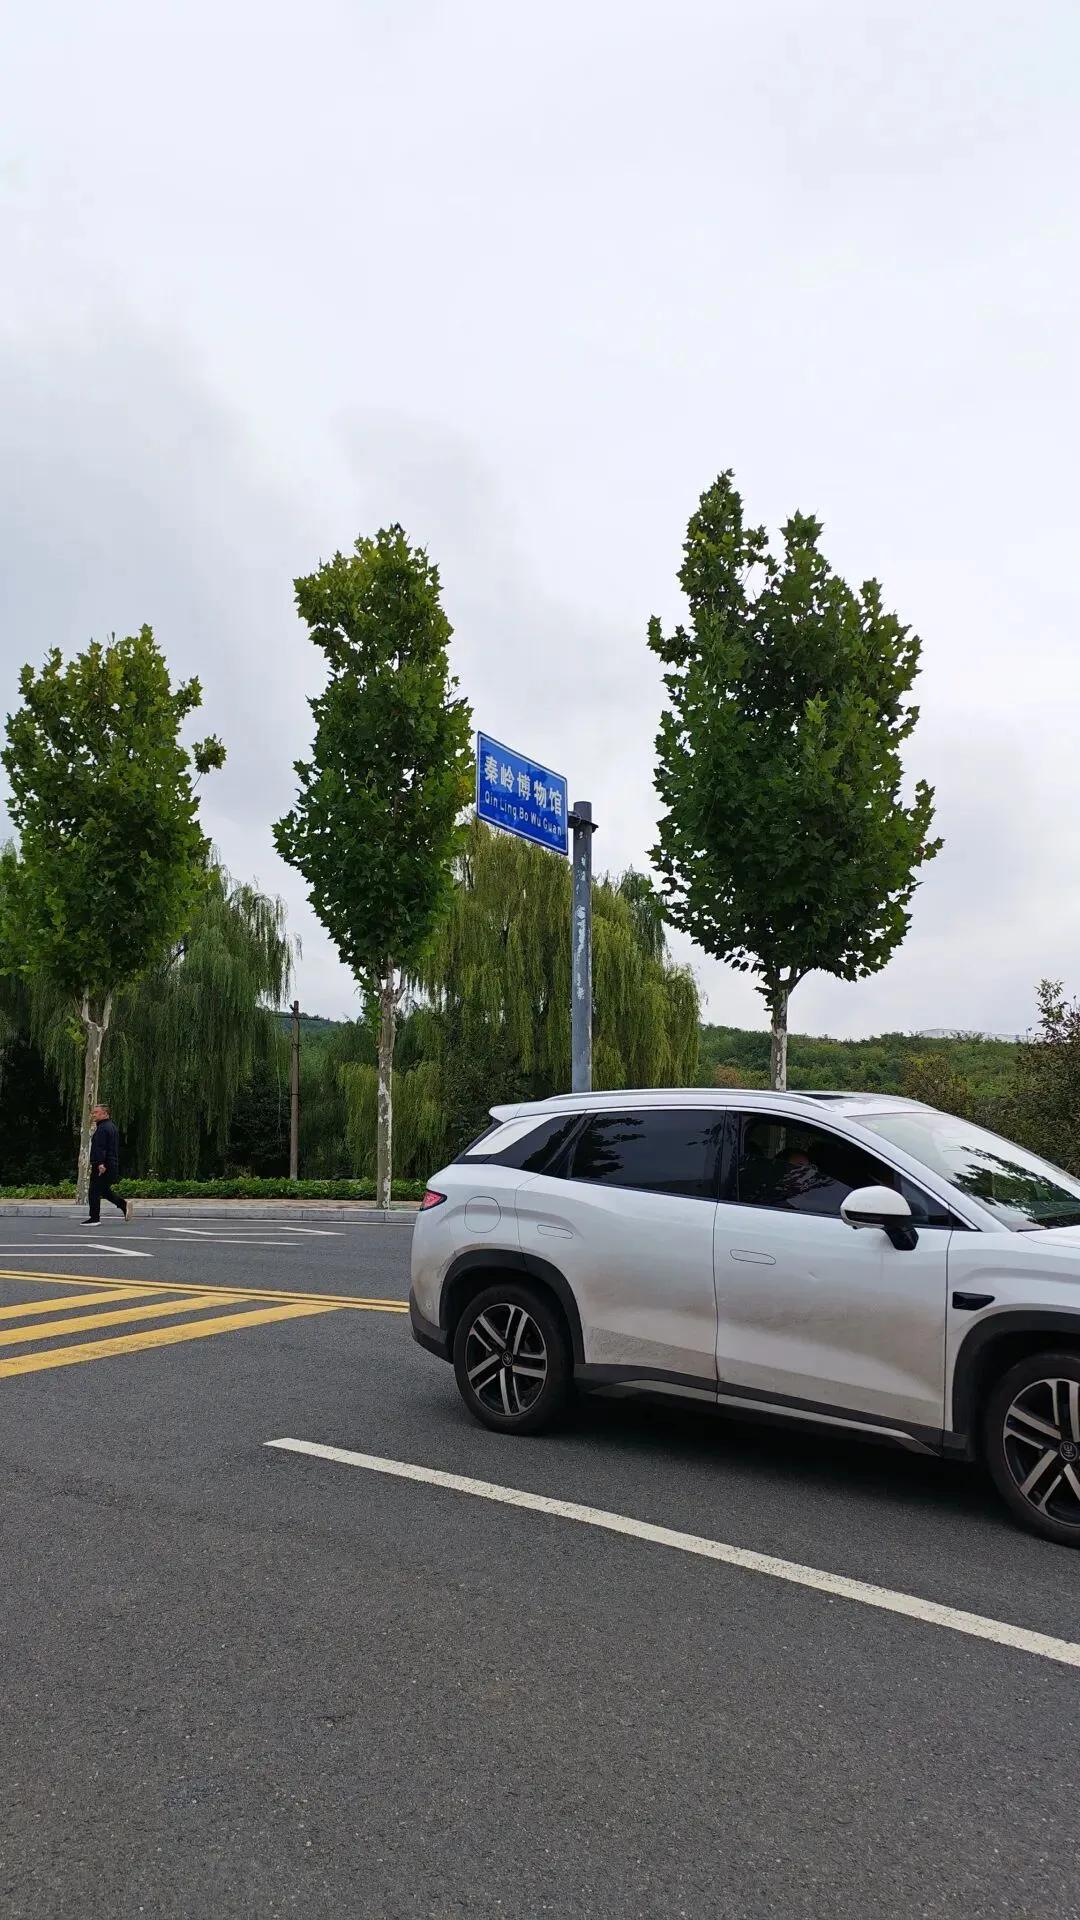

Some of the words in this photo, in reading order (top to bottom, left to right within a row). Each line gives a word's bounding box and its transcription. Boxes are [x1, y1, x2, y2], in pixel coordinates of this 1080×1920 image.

[484, 755, 562, 817] 秦岭博物馆
[484, 791, 498, 808] Qin
[500, 799, 517, 820] Ling
[519, 807, 529, 821] Bo
[531, 811, 541, 826] Wu
[543, 817, 562, 836] Guan
